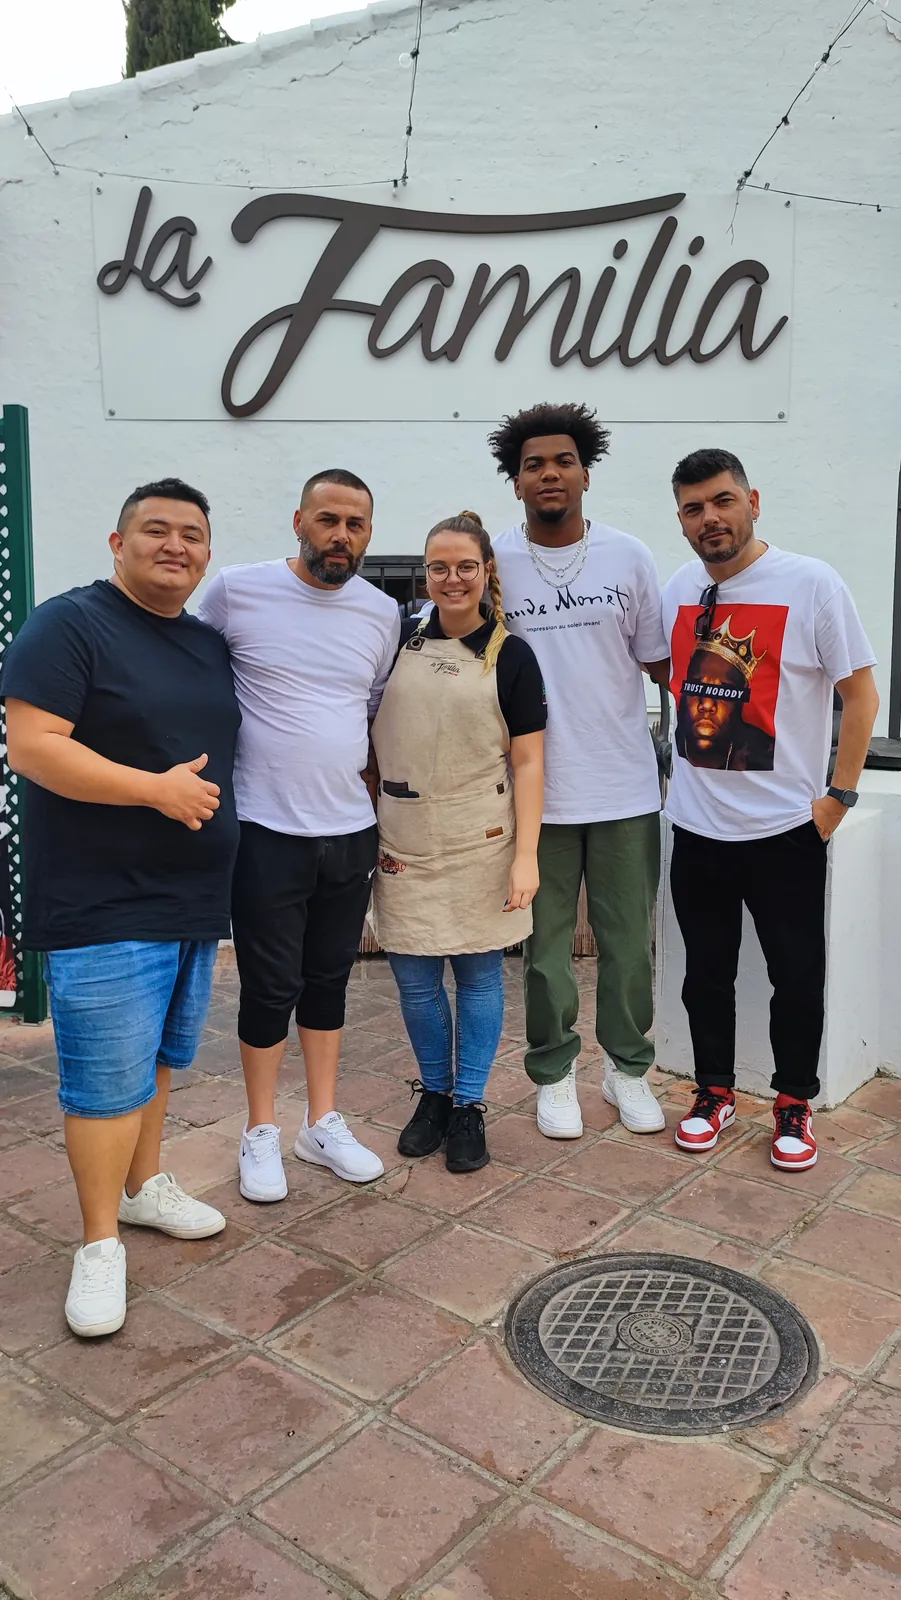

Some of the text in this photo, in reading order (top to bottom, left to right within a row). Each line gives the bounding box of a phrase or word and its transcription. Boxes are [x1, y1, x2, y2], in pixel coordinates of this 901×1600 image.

[96, 185, 790, 418] La Familia
[683, 683, 744, 699] TRUST NOBODY
